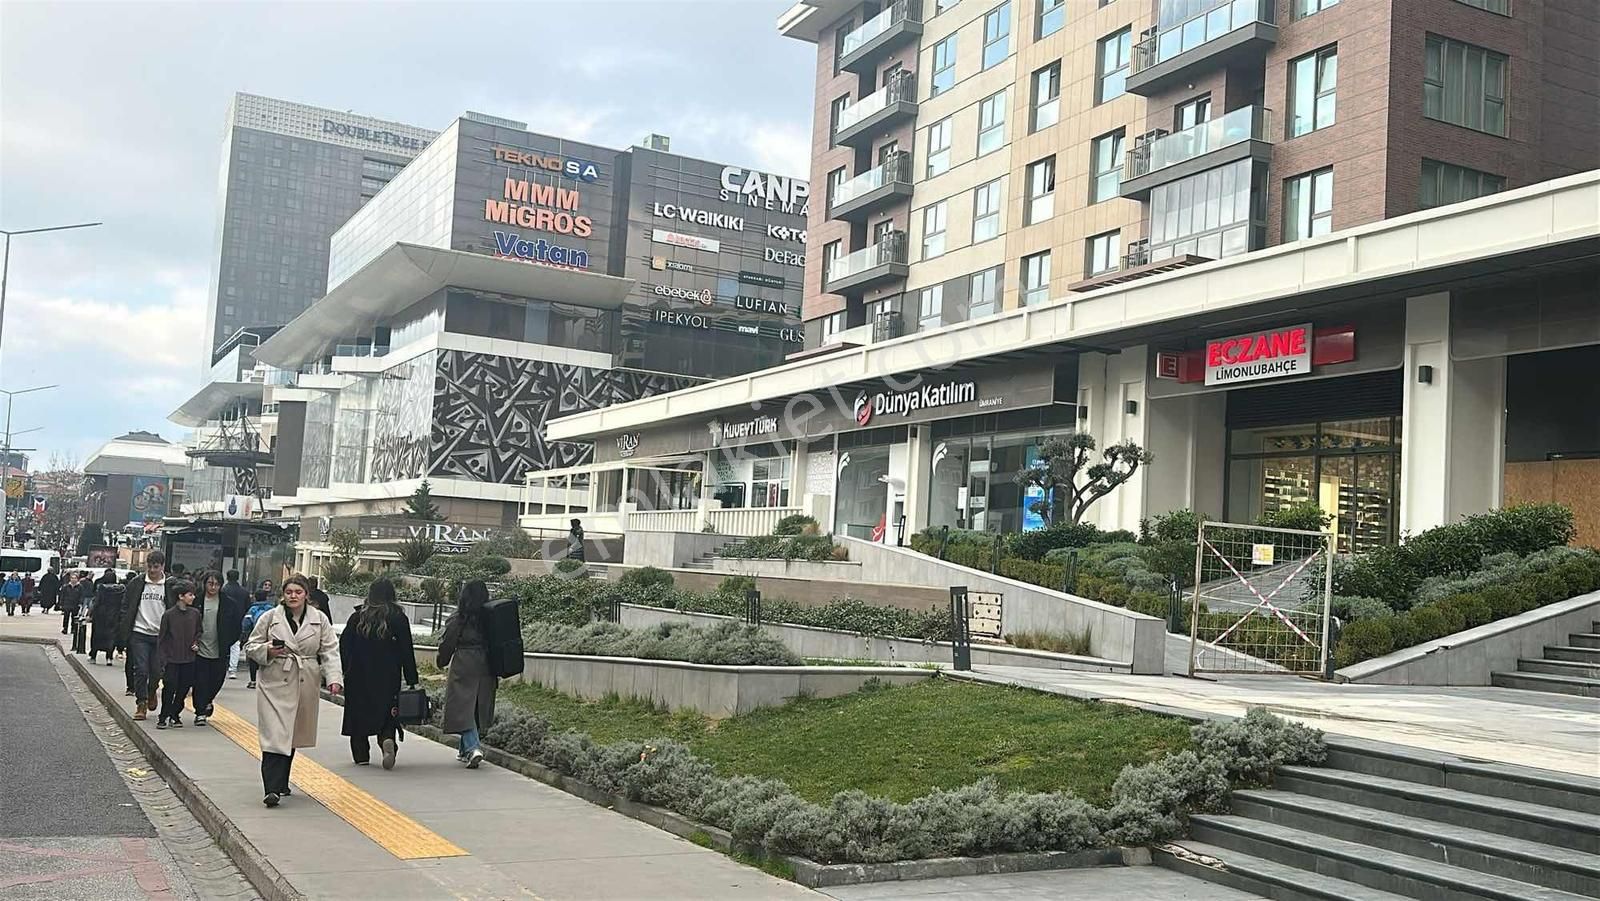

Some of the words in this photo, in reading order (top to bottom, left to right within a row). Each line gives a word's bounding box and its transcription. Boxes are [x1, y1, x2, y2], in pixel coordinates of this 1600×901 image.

[505, 178, 580, 211] MMM
[721, 165, 810, 205] CANP
[654, 202, 676, 218] LC
[494, 231, 588, 268] Vatan
[667, 262, 693, 271] xiaomi
[654, 285, 700, 300] ebebek
[736, 296, 788, 314] LUFIAN
[738, 325, 759, 334] mavi
[1208, 327, 1306, 367] ECZANE
[1216, 359, 1297, 381] LİMONLUBAHÇE
[875, 390, 919, 417] Dünya
[921, 381, 975, 408] Katılım
